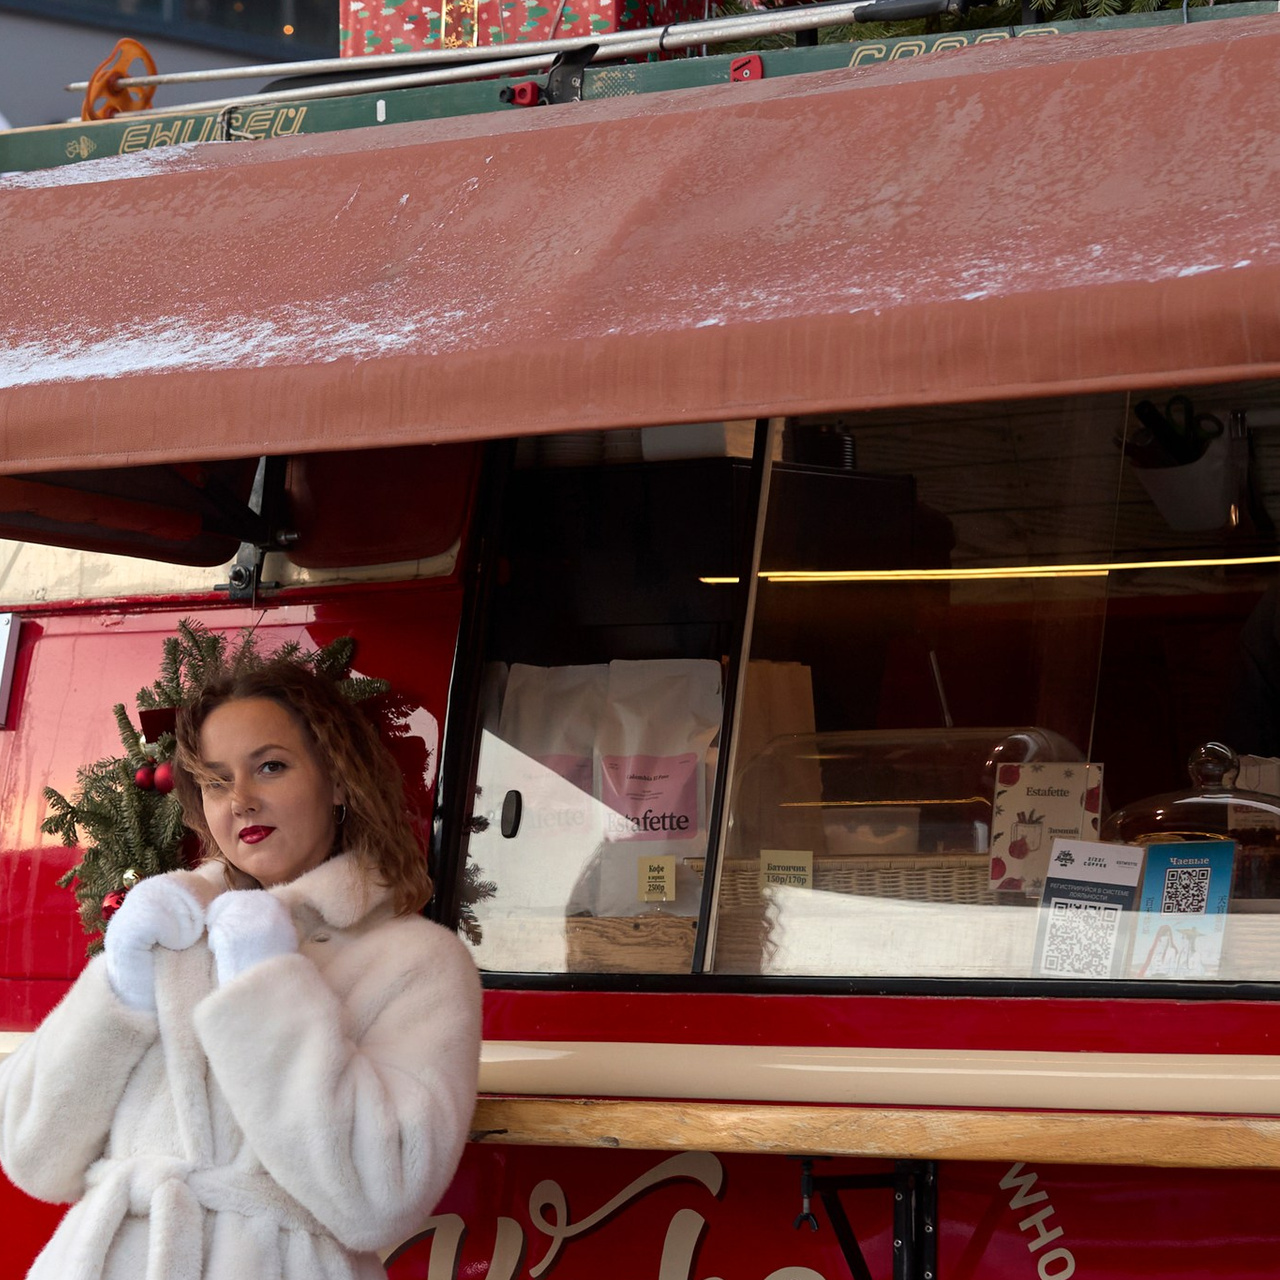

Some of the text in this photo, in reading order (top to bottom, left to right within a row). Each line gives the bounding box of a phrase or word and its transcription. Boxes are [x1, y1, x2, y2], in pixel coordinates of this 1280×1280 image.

[1026, 786, 1070, 798] Estafette
[608, 809, 690, 834] Estafette
[1169, 857, 1210, 866] Чаевые
[648, 864, 665, 874] Кофе
[767, 863, 807, 872] Батончик
